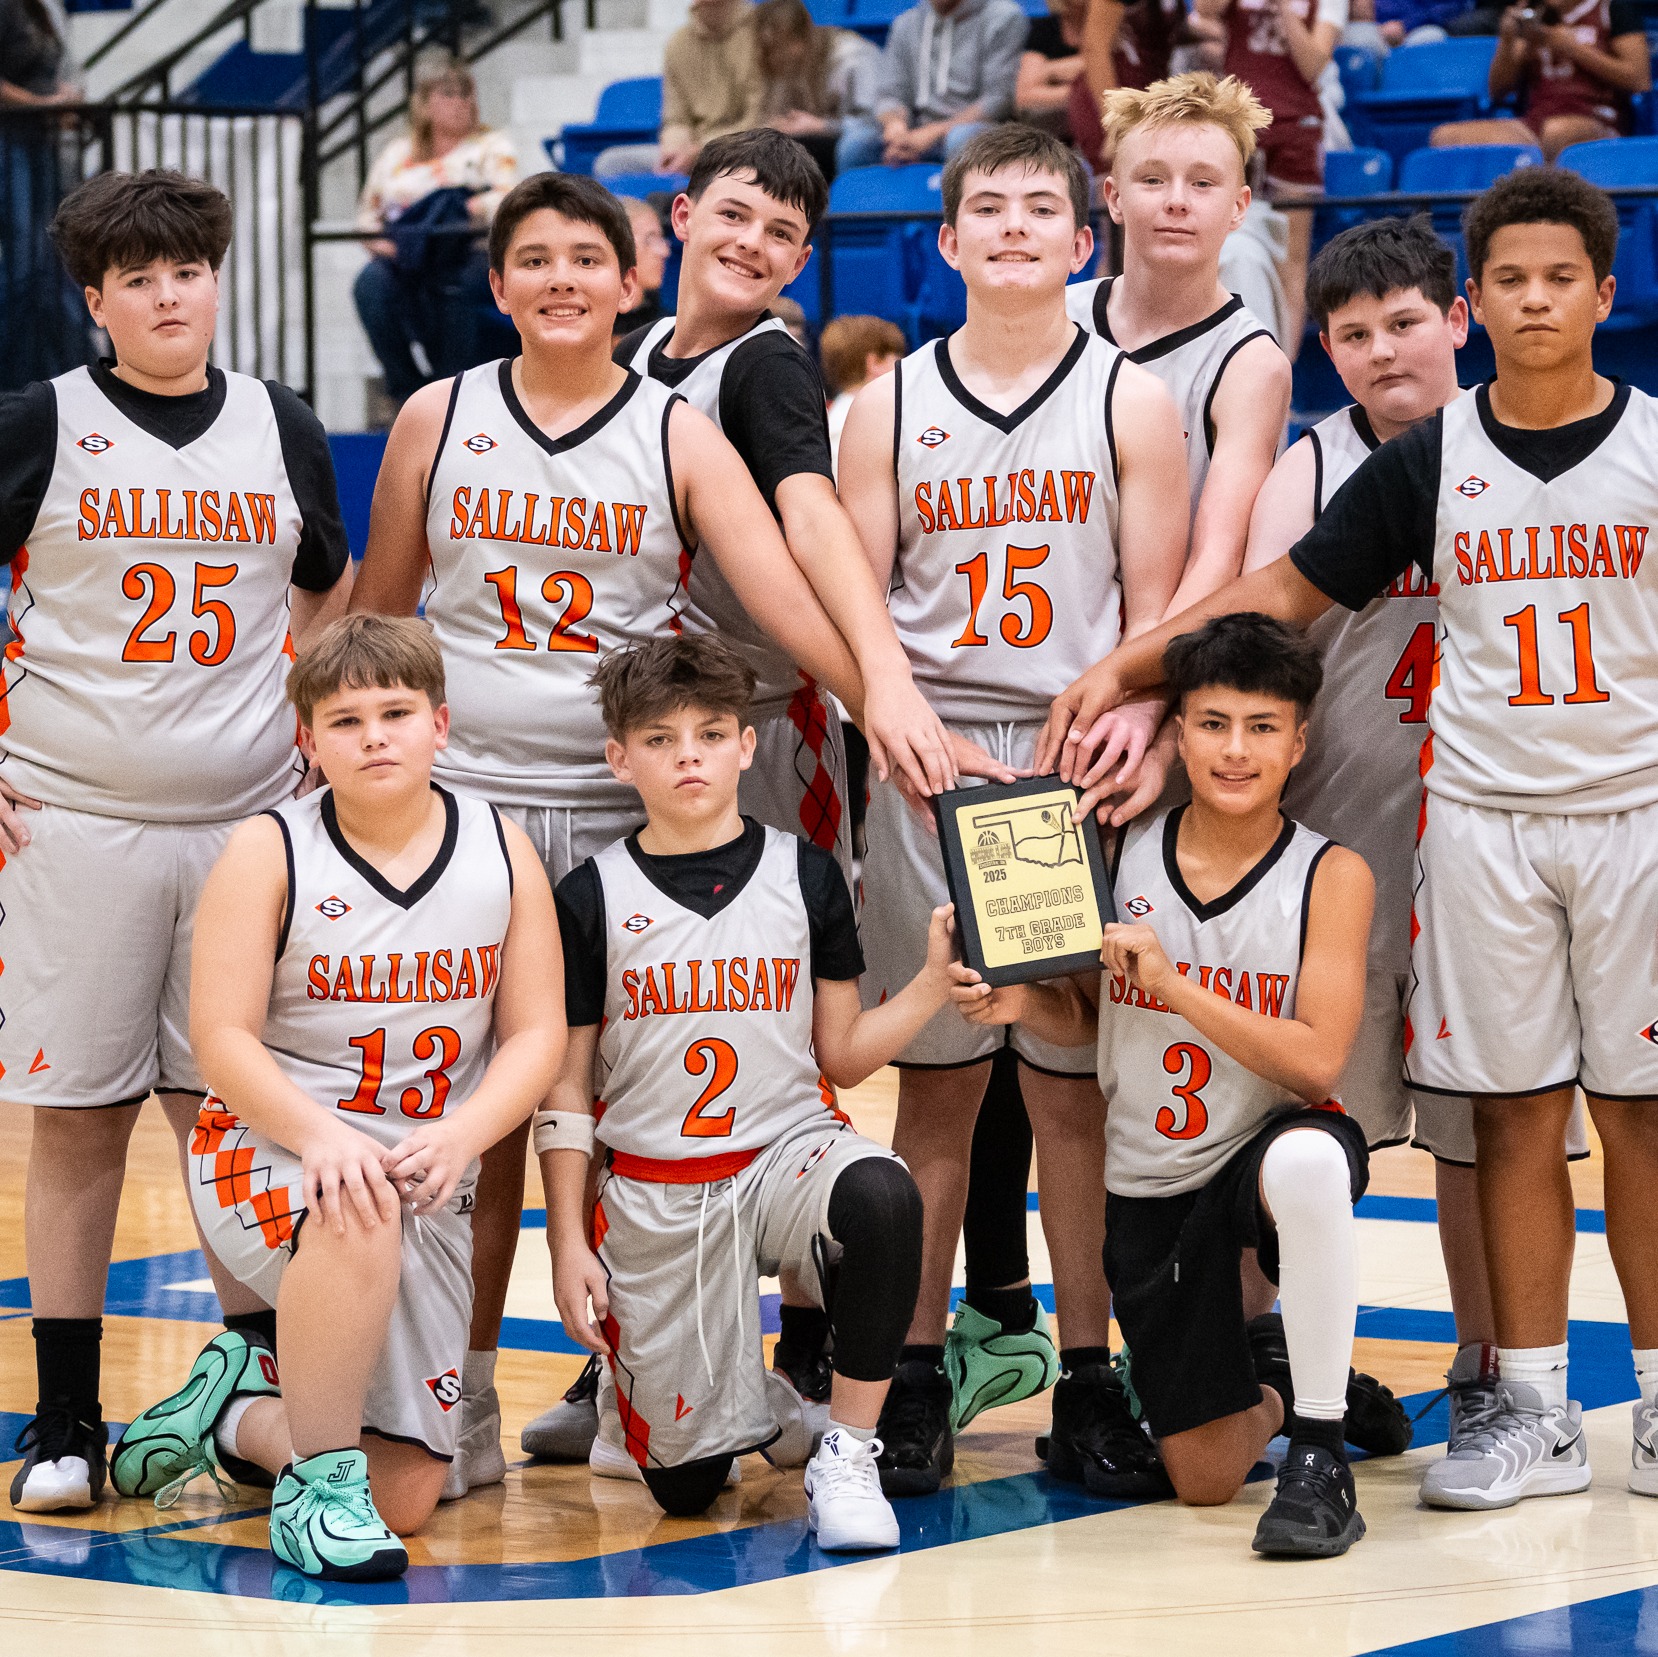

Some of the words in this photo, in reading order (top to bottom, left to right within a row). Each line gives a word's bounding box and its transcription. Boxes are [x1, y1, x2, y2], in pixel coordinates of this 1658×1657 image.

[77, 487, 277, 545] SALLISAW
[450, 485, 648, 557] SALLISAW
[914, 469, 1096, 535] SALLISAW
[1453, 523, 1650, 587] SALLISAW
[121, 561, 239, 667] 25
[483, 564, 600, 655] 12
[950, 543, 1055, 650] 15
[1503, 602, 1611, 707] 11
[983, 868, 1007, 884] 2025
[985, 885, 1085, 918] CHAMPIONS
[995, 924, 1026, 942] 7TH
[1029, 912, 1086, 937] GRADE
[1021, 933, 1066, 955] BOYS
[307, 942, 501, 1004] SALLISAW
[621, 957, 801, 1021] SALLISAW
[336, 1025, 462, 1120] 13
[680, 1036, 739, 1138] 2
[1154, 1041, 1212, 1141] 3
